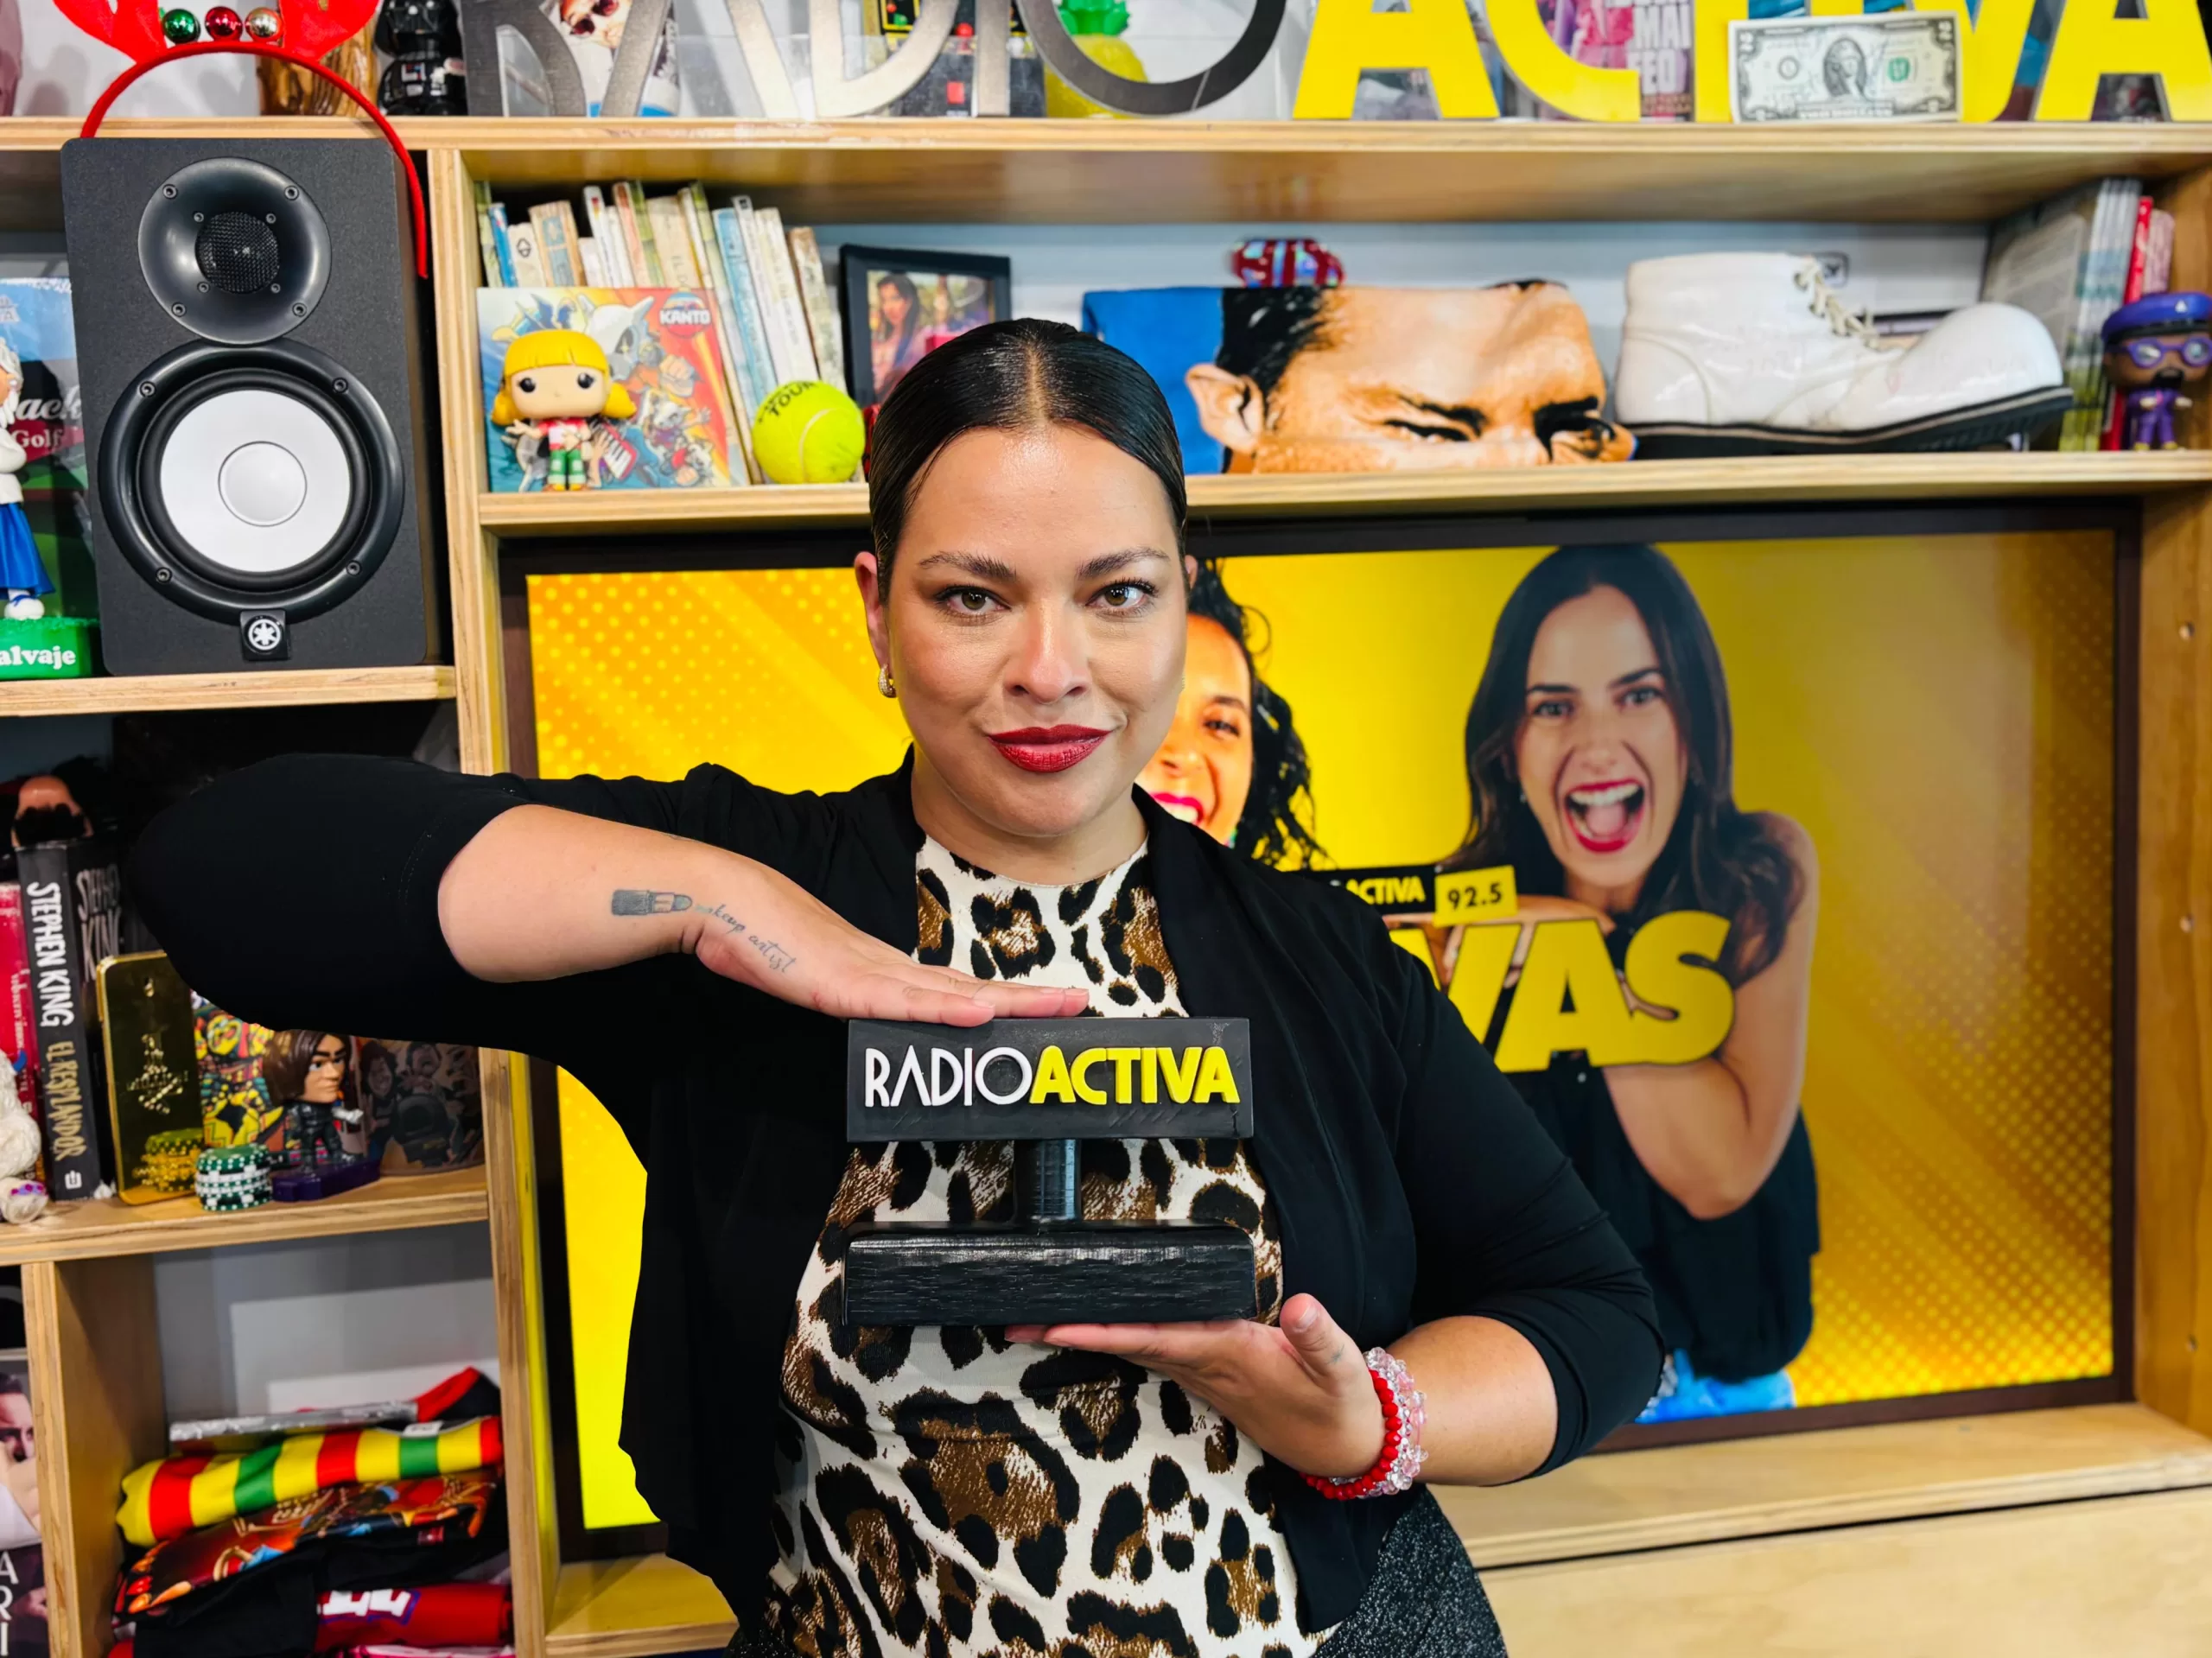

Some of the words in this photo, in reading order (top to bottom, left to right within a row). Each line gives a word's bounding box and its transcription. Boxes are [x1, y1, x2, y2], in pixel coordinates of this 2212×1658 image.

[659, 308, 711, 326] KANTO
[16, 385, 82, 420] ack
[12, 429, 65, 449] Golf
[0, 645, 76, 670] alvaje
[1447, 882, 1503, 911] 92.5
[27, 880, 67, 968] STEPHEN
[38, 969, 75, 1028] KING
[1389, 910, 1735, 1073] VAS
[46, 1040, 75, 1062] EL
[865, 1045, 1241, 1108] RADIOACTIVA
